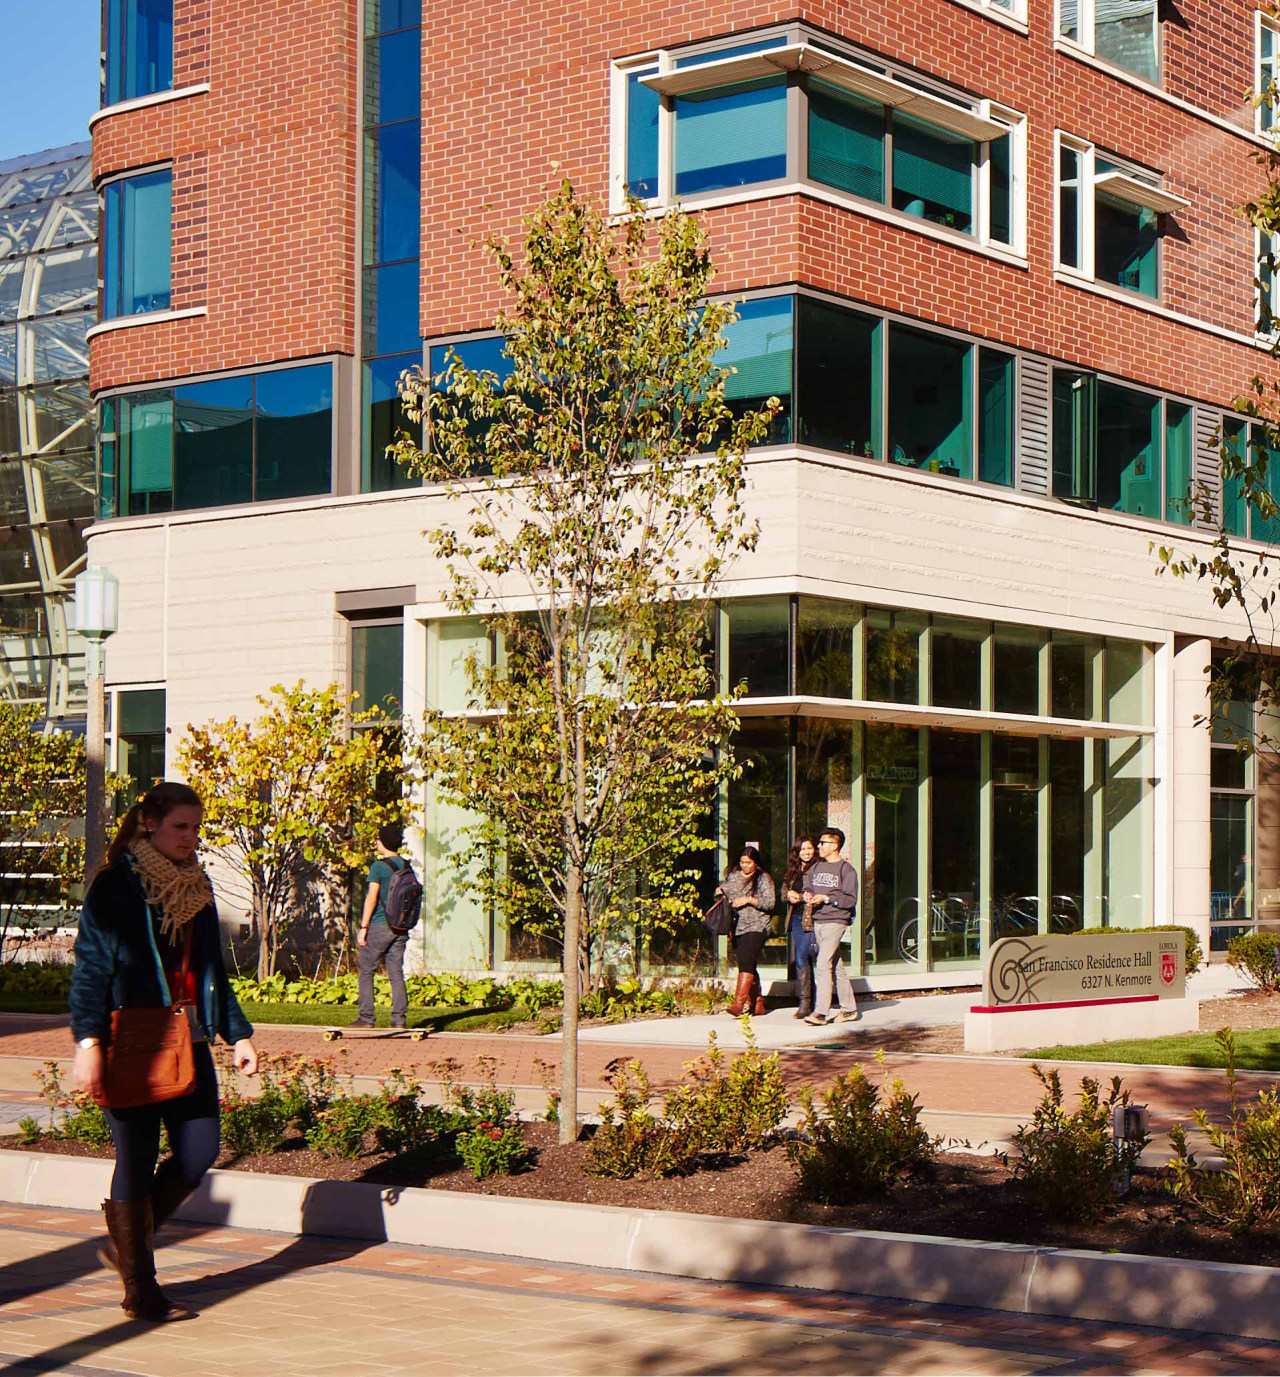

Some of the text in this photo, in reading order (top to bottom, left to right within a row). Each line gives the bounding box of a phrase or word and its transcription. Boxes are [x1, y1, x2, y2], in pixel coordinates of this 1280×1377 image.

[1017, 951, 1152, 973] San Francisco Residence Hall
[1081, 973, 1152, 990] 6327 N. Kenmore
